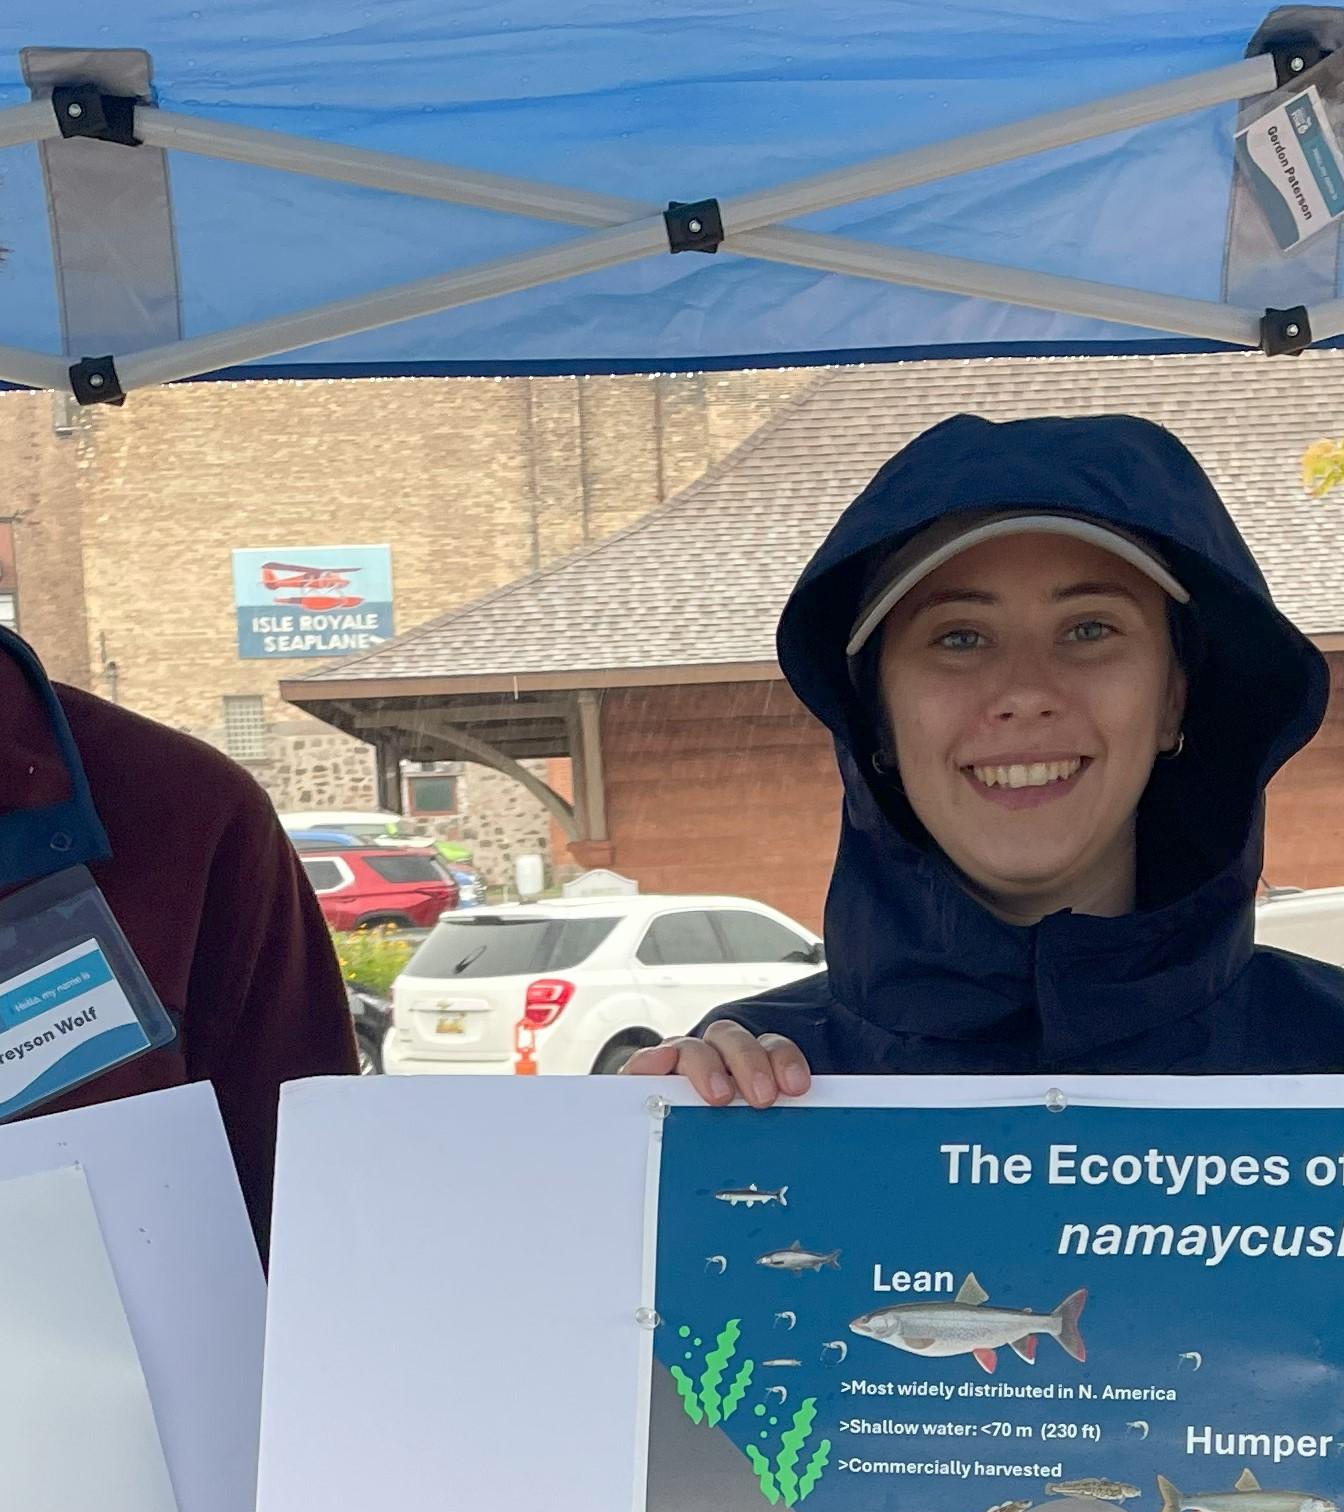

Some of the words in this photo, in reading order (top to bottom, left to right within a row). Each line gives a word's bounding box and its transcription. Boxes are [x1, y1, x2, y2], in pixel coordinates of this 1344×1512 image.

[1267, 126, 1289, 168] Gordon
[1284, 166, 1313, 221] Paterson
[252, 615, 294, 633] ISLE
[299, 613, 379, 632] ROYALE
[54, 1006, 98, 1034] Wolf
[940, 1143, 1032, 1185] The
[1049, 1144, 1290, 1196] Ecotypes
[873, 1263, 954, 1293] Lean
[840, 1379, 895, 1396] >Most
[897, 1381, 956, 1401] widely
[957, 1382, 1055, 1399] distributed
[1057, 1383, 1074, 1399] in
[1078, 1383, 1098, 1400] N.
[1101, 1384, 1177, 1402] America
[839, 1418, 920, 1435] >Shallow
[921, 1421, 978, 1437] water:
[980, 1421, 1013, 1438] <70
[1015, 1425, 1033, 1438] m
[1040, 1422, 1078, 1441] (230
[1081, 1423, 1102, 1443] ft)
[1186, 1425, 1334, 1464] Humper
[837, 1457, 972, 1479] >Commercially
[973, 1461, 1063, 1479] harvested
